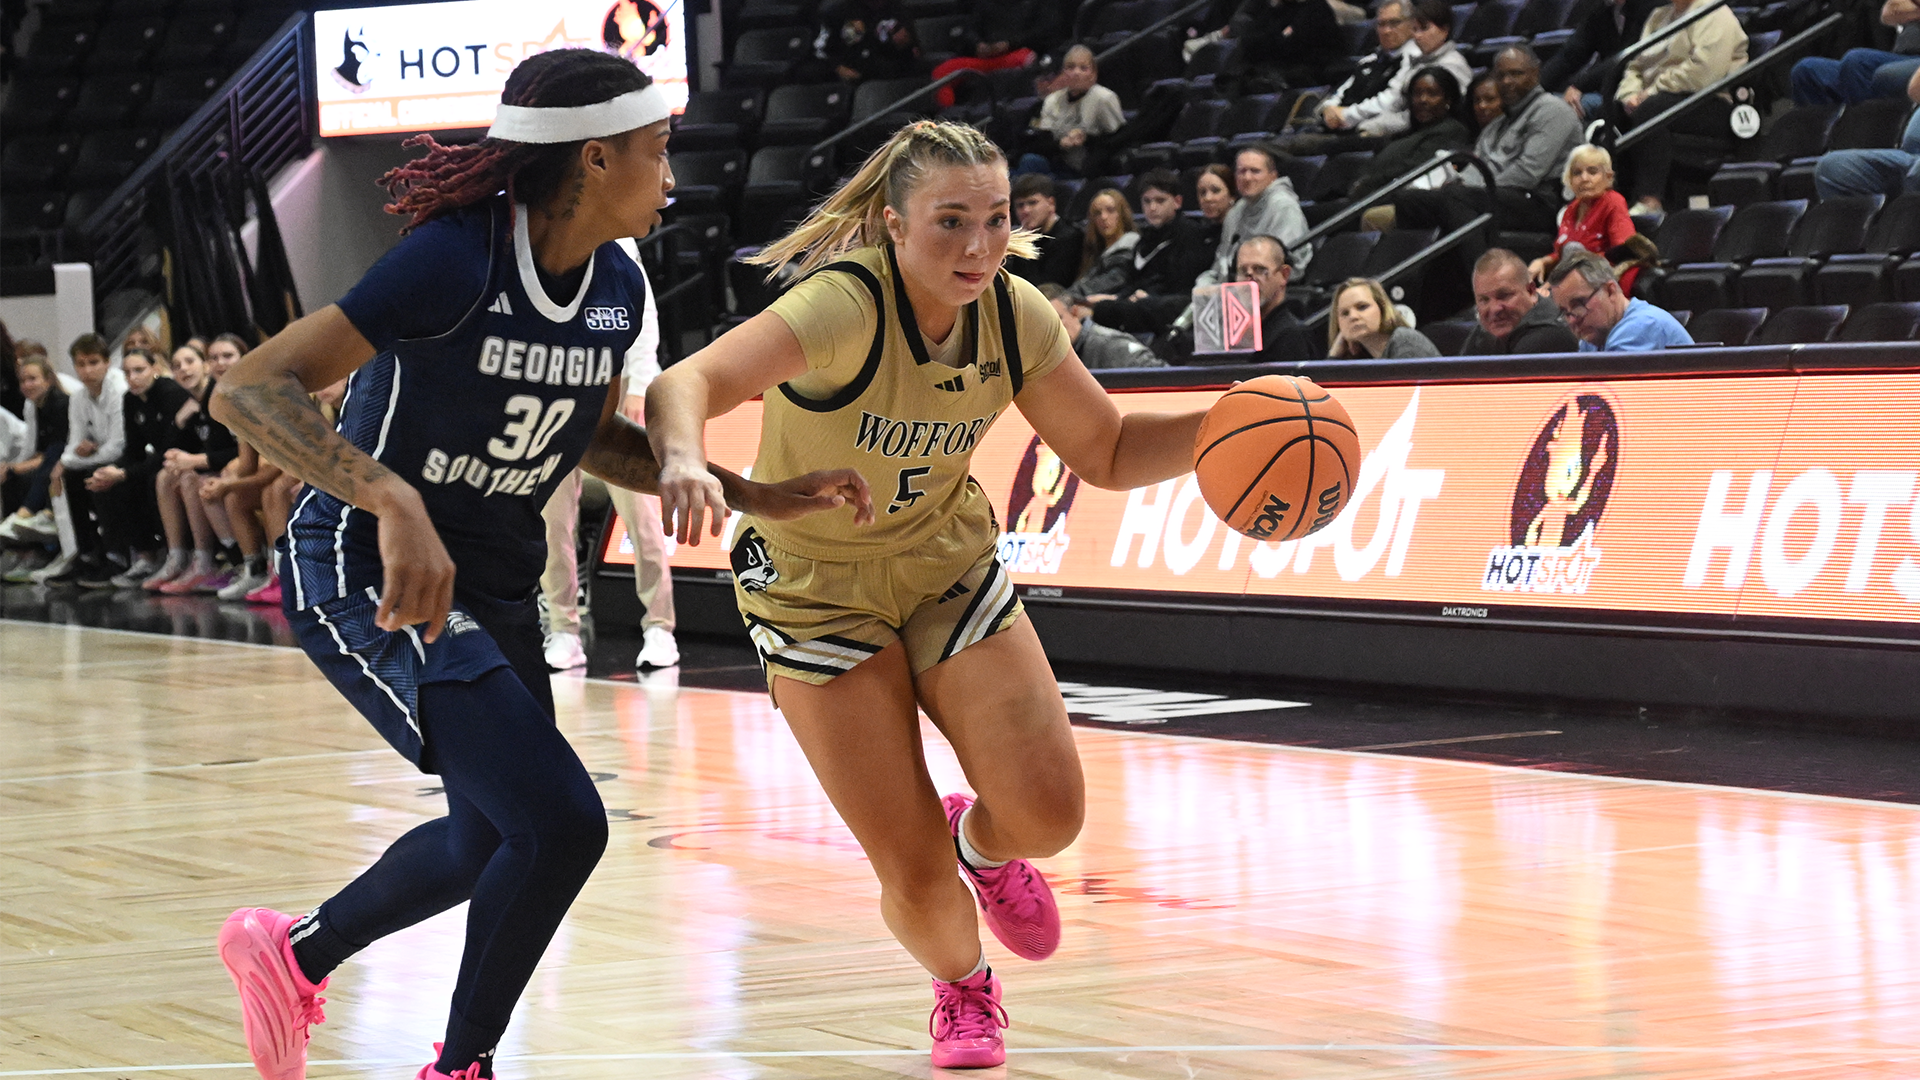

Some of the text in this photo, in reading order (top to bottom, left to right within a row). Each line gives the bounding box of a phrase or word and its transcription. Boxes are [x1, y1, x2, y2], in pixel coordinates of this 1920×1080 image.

[400, 25, 592, 79] HOTS
[584, 306, 630, 330] SBC
[478, 335, 614, 387] GEORGIA
[487, 393, 576, 462] 30
[421, 447, 563, 498] SOUTHEN
[886, 465, 934, 515] 5
[1110, 425, 1446, 582] HOOT
[999, 533, 1067, 570] OTSPOT
[1485, 545, 1599, 588] HOTSPOT
[1442, 606, 1488, 618] DAKTRONICS
